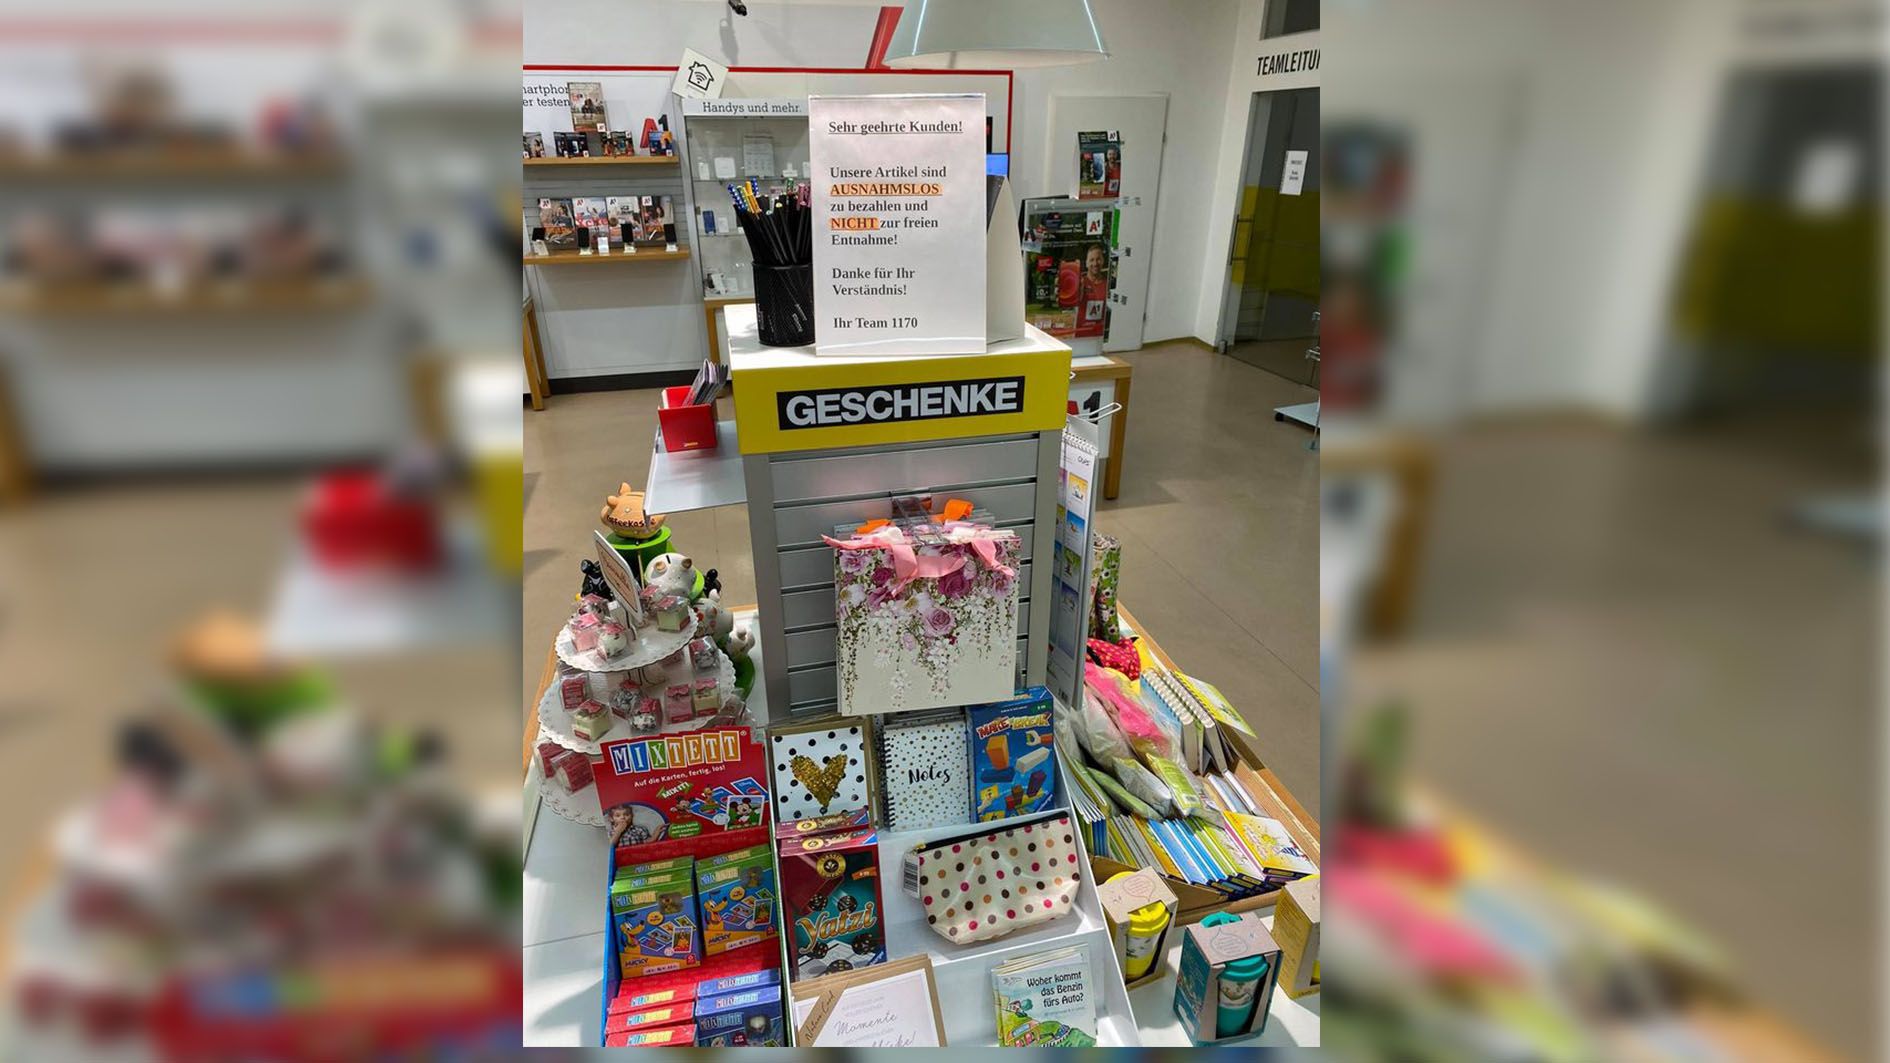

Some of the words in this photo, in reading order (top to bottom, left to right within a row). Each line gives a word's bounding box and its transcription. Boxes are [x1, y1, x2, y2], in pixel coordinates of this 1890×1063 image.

[703, 102, 745, 114] Handys
[747, 102, 768, 113] und
[828, 121, 856, 133] Sehr
[860, 121, 906, 135] geehrte
[909, 121, 963, 133] Kunden!
[830, 167, 872, 178] Unsere
[875, 166, 918, 178] Artikel
[921, 166, 947, 178] sind
[830, 183, 939, 195] AUSNAHMSLOS
[830, 202, 844, 212] zu
[848, 201, 901, 212] bezahlen
[905, 200, 928, 211] und
[831, 218, 878, 230] NICHT
[880, 219, 900, 229] zur
[904, 216, 939, 228] freien
[831, 234, 898, 246] Entnahme!
[832, 268, 871, 280] Danke
[874, 267, 893, 280] für
[896, 267, 915, 279] Ihr
[832, 284, 907, 296] Verständnis!
[833, 318, 853, 329] Ihr
[855, 318, 888, 329] Team
[892, 317, 918, 329] 1170
[786, 381, 1018, 427] GESCHENKE
[611, 733, 738, 773] MIXTETT
[634, 780, 647, 788] Auf
[648, 777, 660, 785] die
[661, 772, 688, 783] Karten,
[689, 767, 711, 777] fertig,
[712, 764, 726, 772] los!
[908, 764, 951, 785] Notes
[795, 901, 877, 953] Yatzi
[1026, 976, 1053, 987] Woher
[1054, 971, 1082, 983] kommt
[1040, 987, 1055, 997] das
[1057, 981, 1083, 994] Benzin
[1043, 997, 1060, 1008] fürs
[1061, 992, 1084, 1005] Auto?
[834, 1010, 897, 1037] Momente
